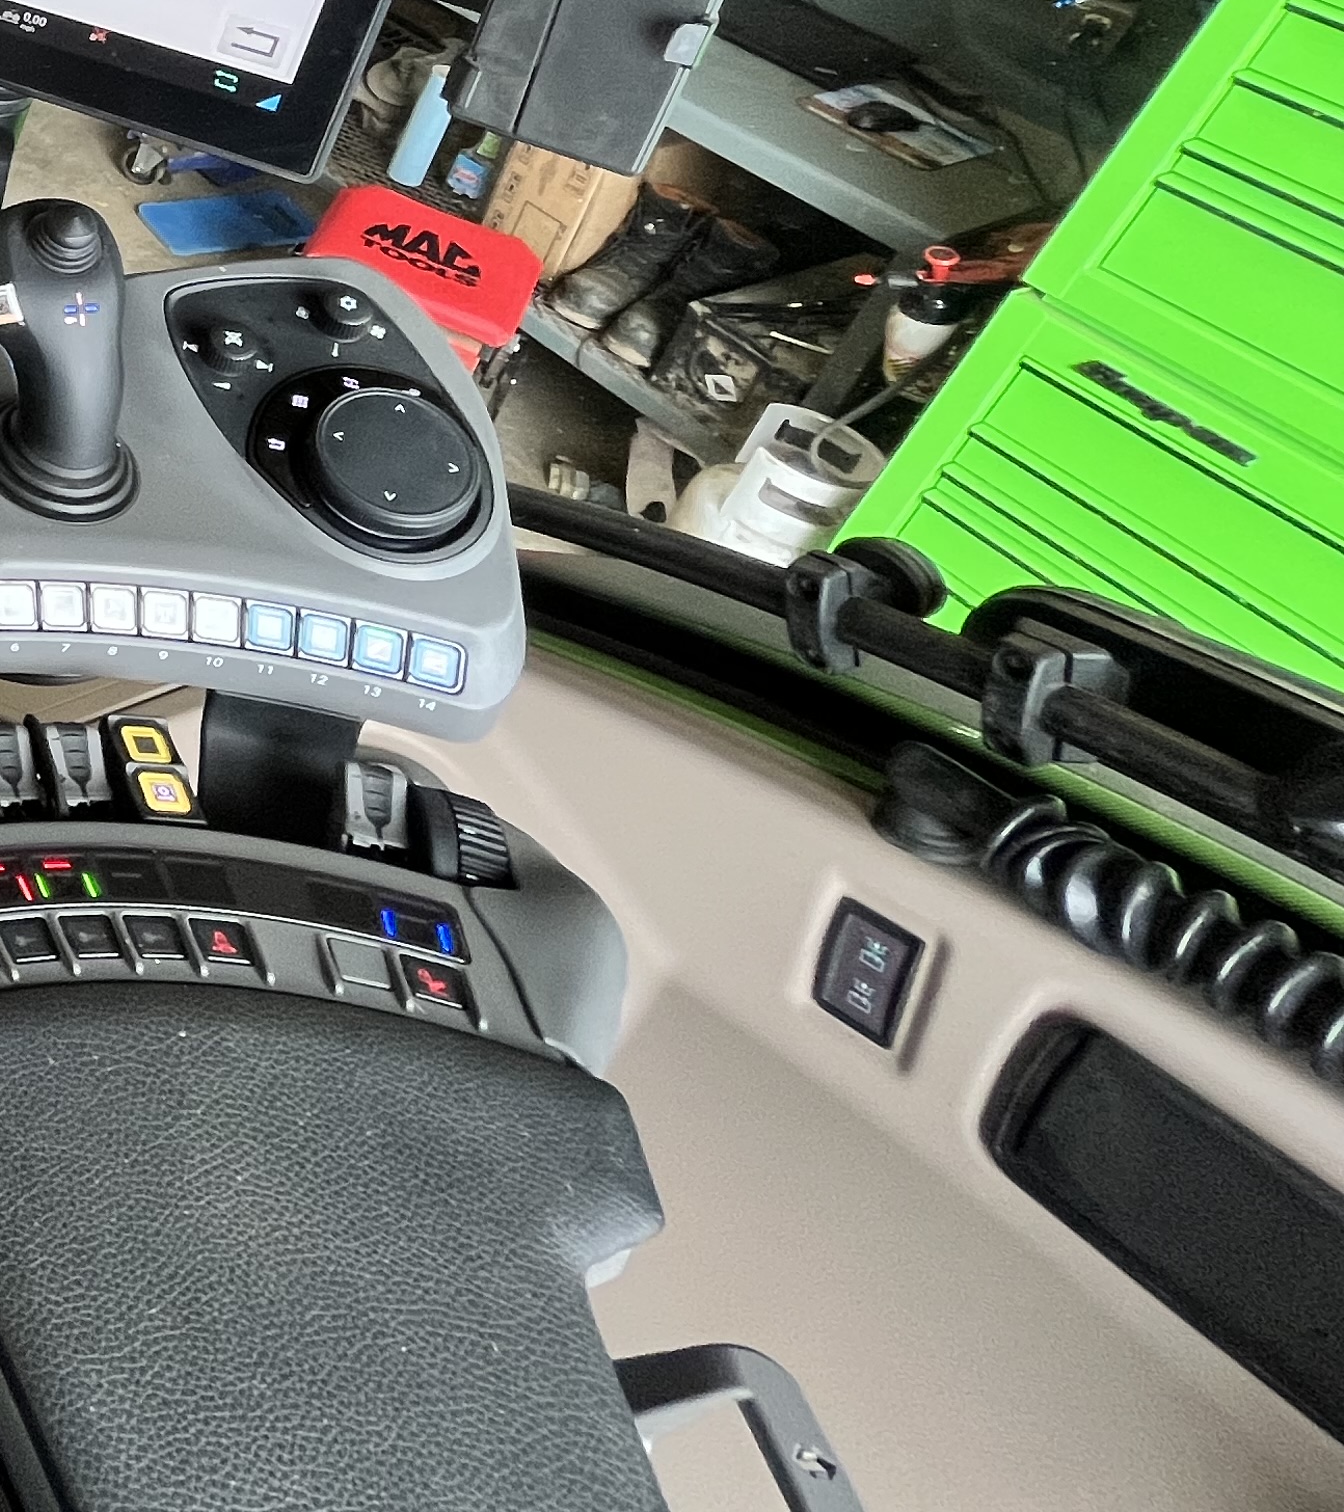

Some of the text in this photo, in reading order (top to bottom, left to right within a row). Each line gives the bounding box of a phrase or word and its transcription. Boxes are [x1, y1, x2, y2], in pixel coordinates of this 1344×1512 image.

[361, 223, 482, 280] MAC
[364, 237, 481, 287] TOOLS
[206, 656, 224, 668] 10
[257, 664, 274, 675] 11
[310, 673, 328, 686] 12
[364, 685, 382, 698] 13
[418, 698, 436, 712] 14
